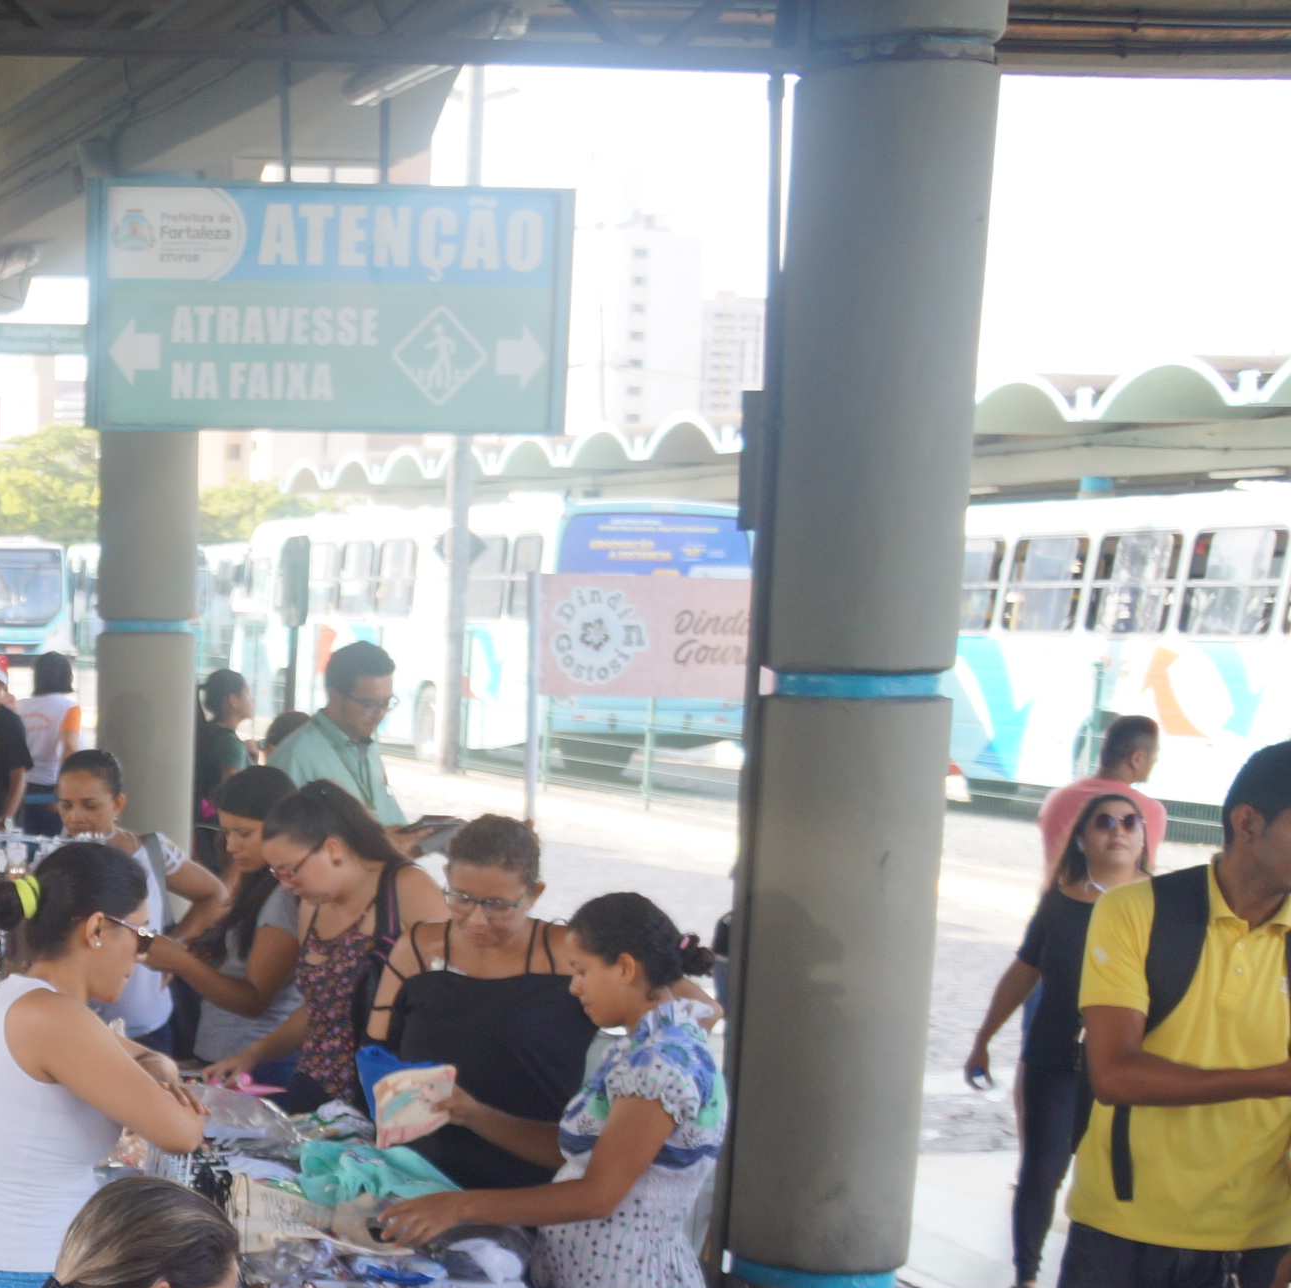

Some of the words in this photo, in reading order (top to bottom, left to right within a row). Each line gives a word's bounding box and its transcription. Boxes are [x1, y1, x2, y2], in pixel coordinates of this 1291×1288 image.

[160, 224, 232, 240] Fortaleza
[218, 212, 232, 222] de
[258, 197, 544, 282] ATENÇÃO
[170, 306, 379, 347] ATRAVESSE
[170, 361, 218, 400] NA
[228, 362, 335, 401] FAIXA
